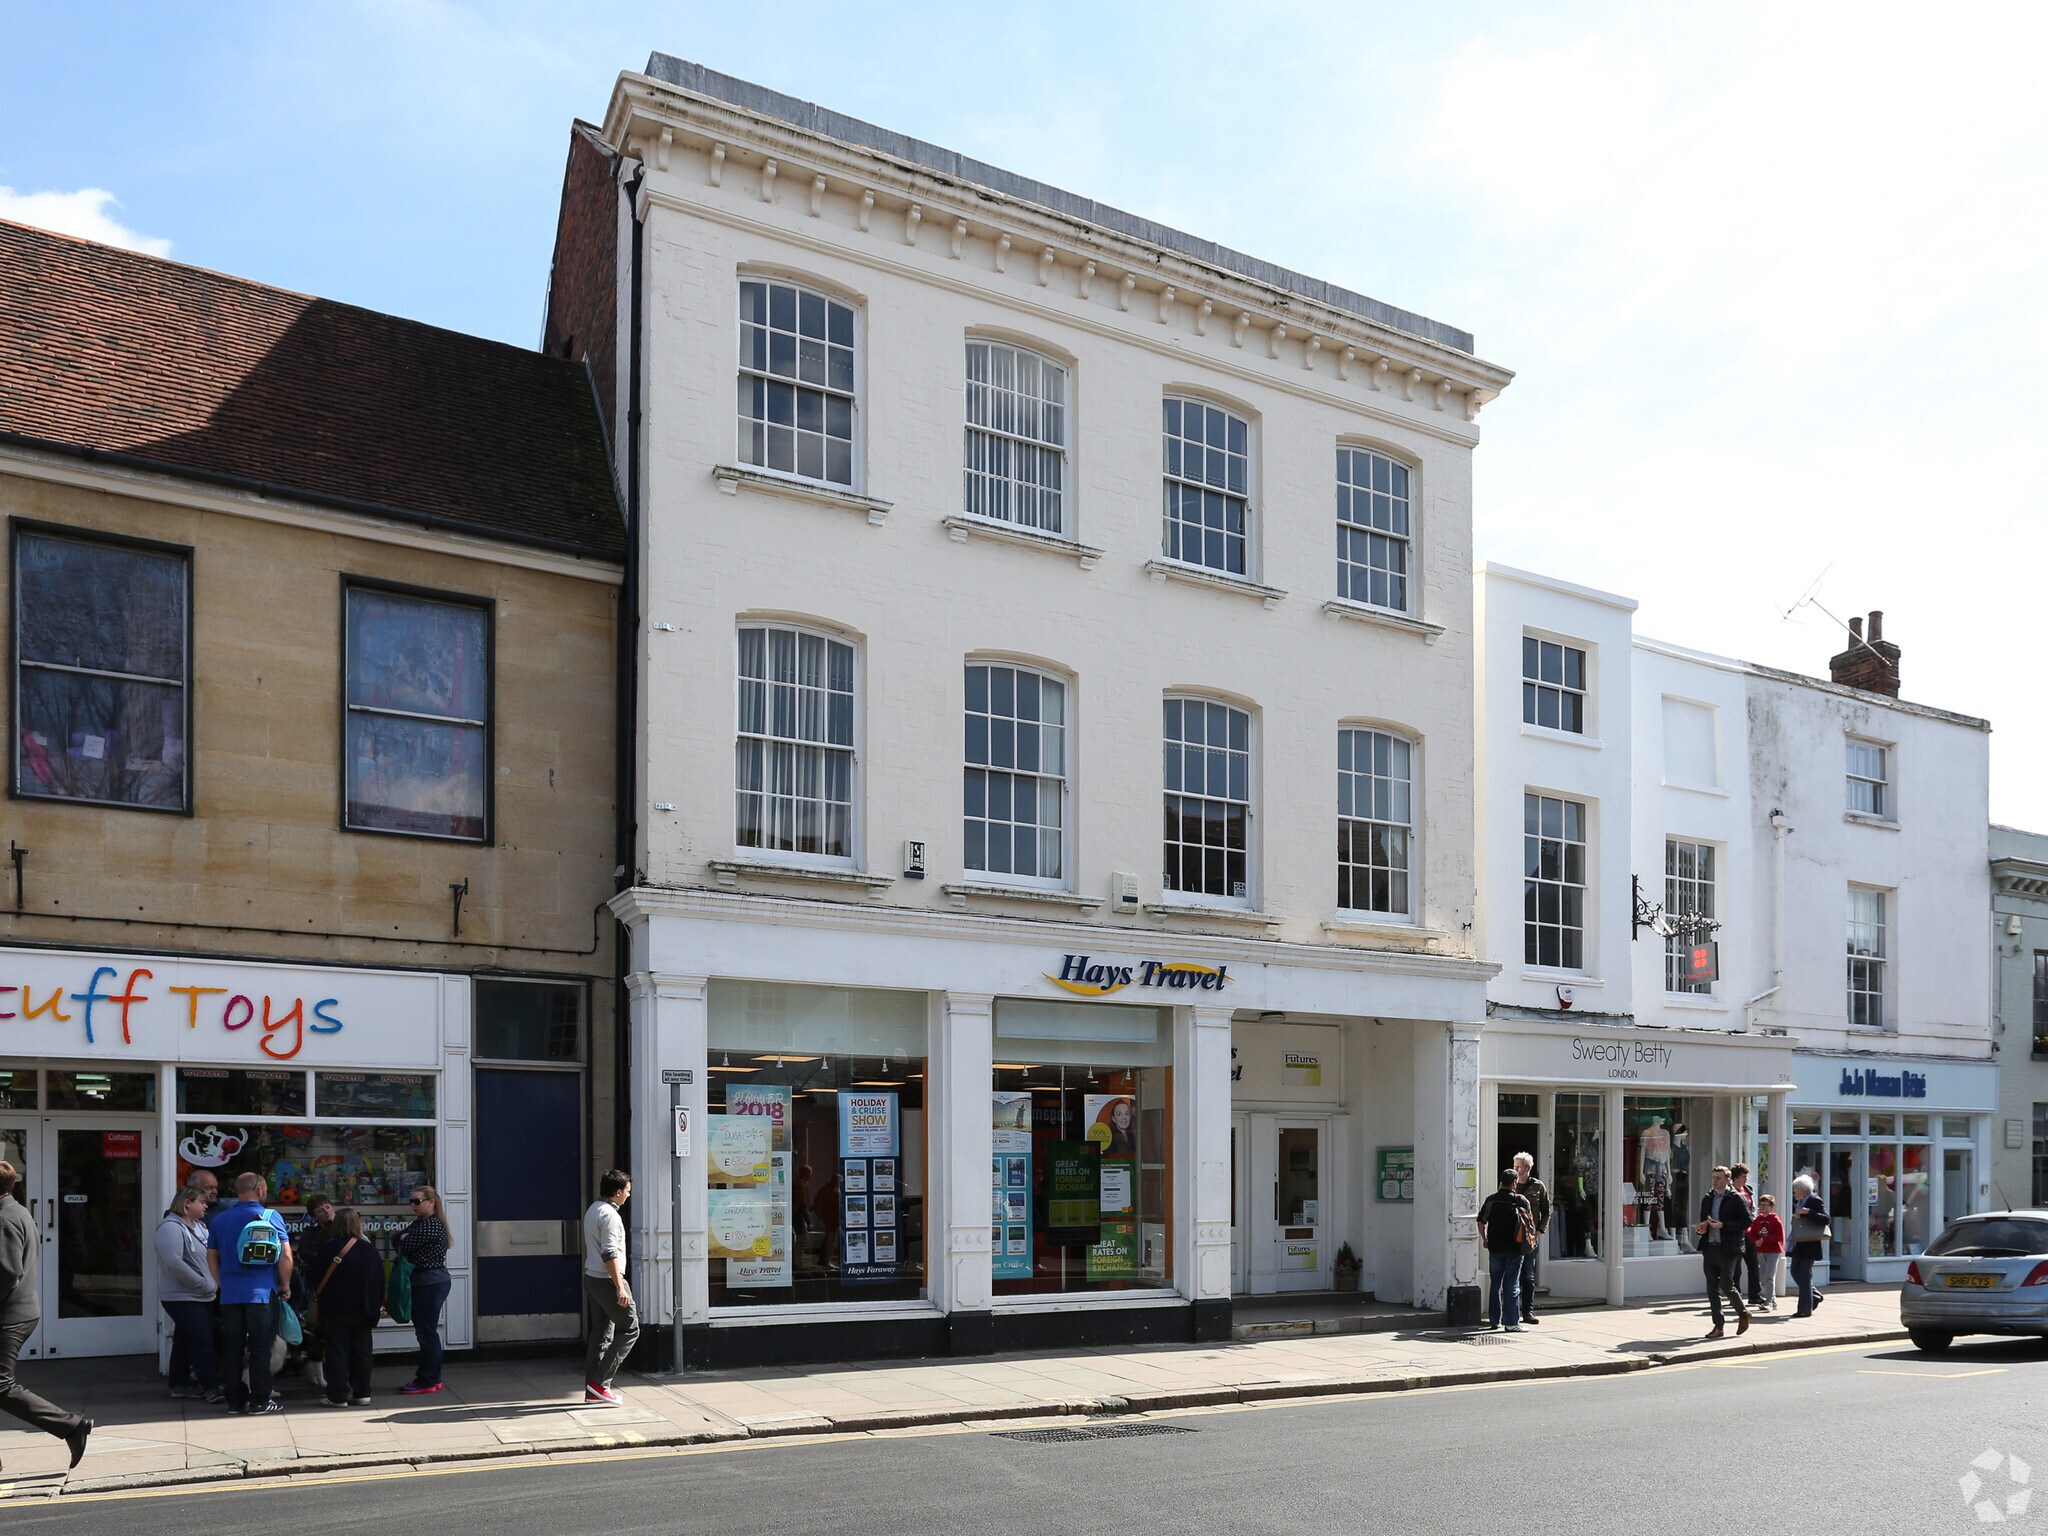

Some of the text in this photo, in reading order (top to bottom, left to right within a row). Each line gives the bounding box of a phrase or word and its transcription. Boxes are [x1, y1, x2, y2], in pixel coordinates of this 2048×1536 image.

[1058, 954, 1228, 991] Hays Travel
[168, 985, 344, 1060] Toys
[1572, 1038, 1673, 1069] Sweaty Betty
[1285, 1054, 1318, 1064] Futures
[183, 1069, 229, 1078] TOYMASTER
[245, 1071, 291, 1080] TOYMASTER
[1608, 1069, 1638, 1079] LONDON
[322, 1074, 365, 1083] TOYMASTER
[380, 1076, 422, 1084] TOYMASTER
[850, 1098, 887, 1107] HOLIDAY
[734, 1101, 784, 1120] 2018
[859, 1107, 887, 1115] CRUISE
[852, 1114, 887, 1126] SHOW
[1055, 1160, 1079, 1168] GREAT
[1055, 1168, 1090, 1176] RATES ON
[1055, 1176, 1087, 1184] FOREIGN
[1055, 1184, 1094, 1192] EXCHANGE
[383, 1220, 413, 1232] GAM
[1092, 1247, 1128, 1257] RATES ON
[1092, 1256, 1124, 1265] FOREIGN
[739, 1267, 757, 1275] Hays
[847, 1266, 896, 1276] Hays Faraway
[1092, 1263, 1132, 1273] EXCHANGE
[1950, 1277, 1990, 1285] SH61 CYS
